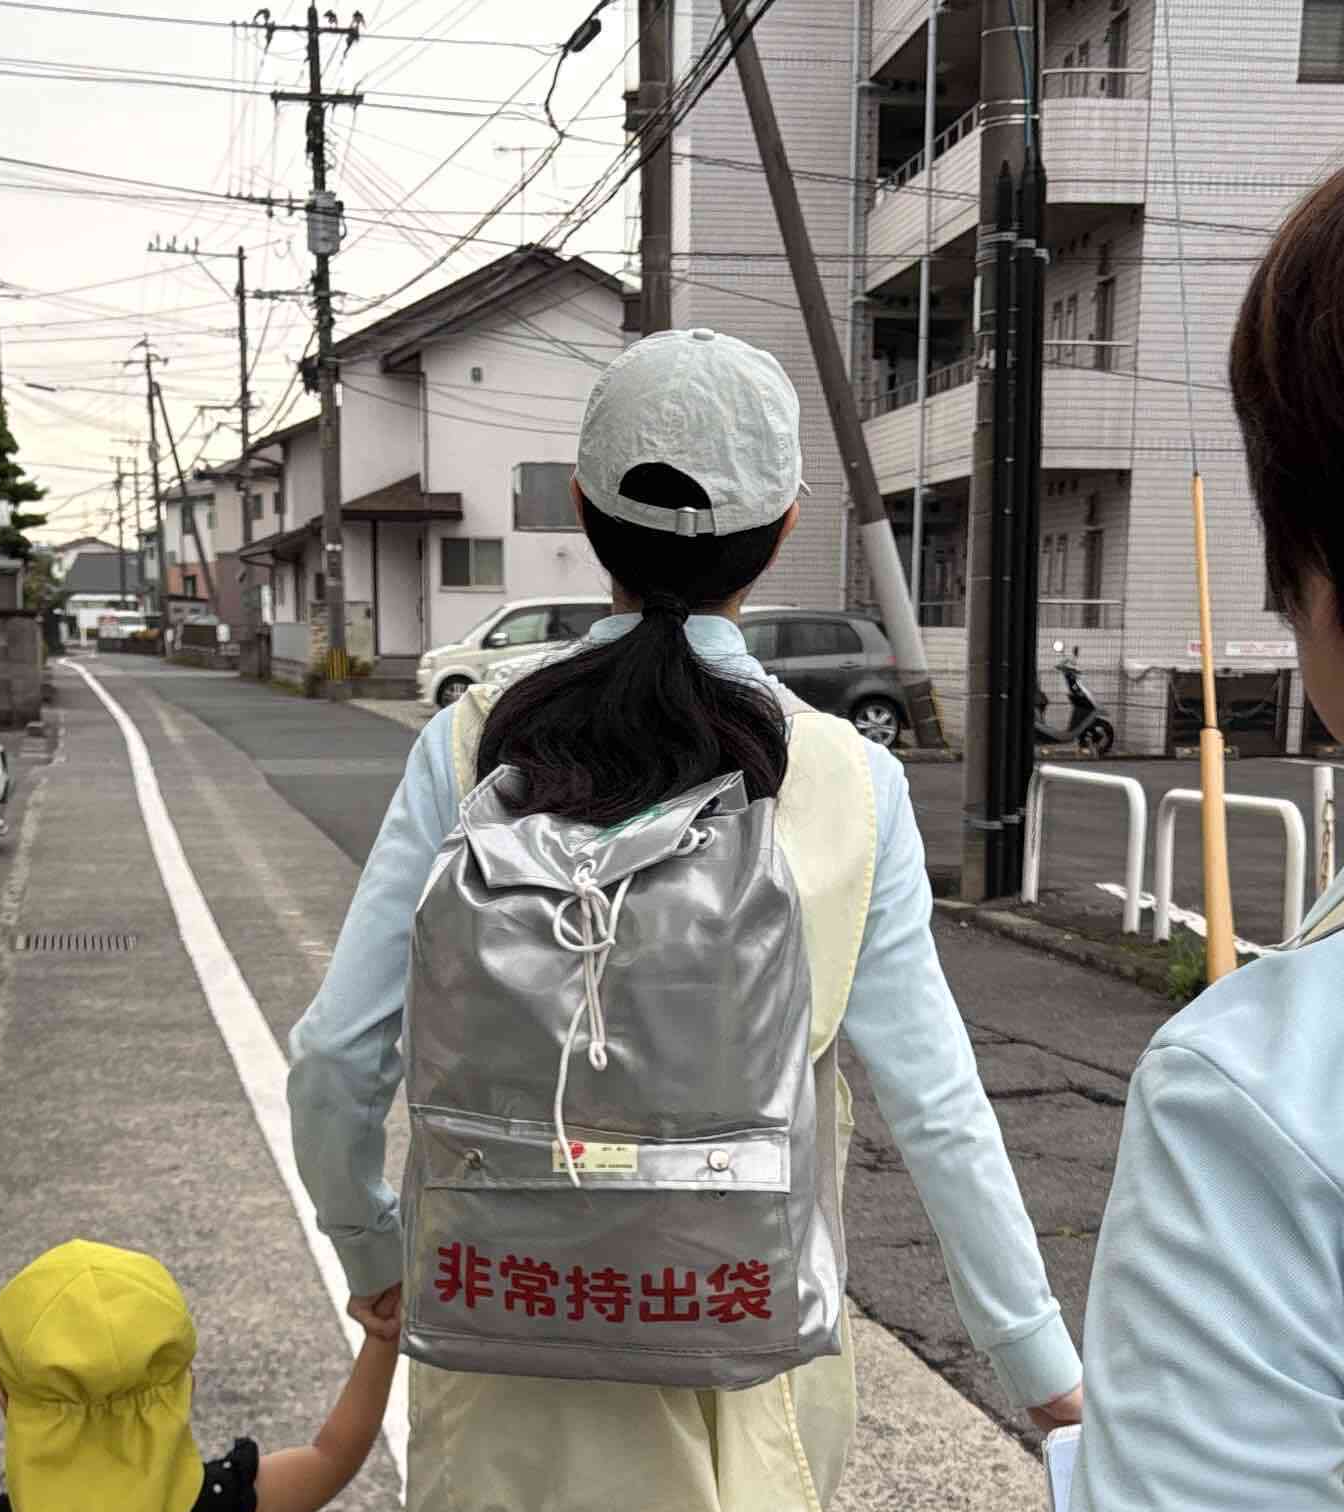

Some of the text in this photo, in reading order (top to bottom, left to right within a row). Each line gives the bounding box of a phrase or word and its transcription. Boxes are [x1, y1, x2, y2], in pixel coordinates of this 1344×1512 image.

[433, 1241, 773, 1324] 非常持出袋
